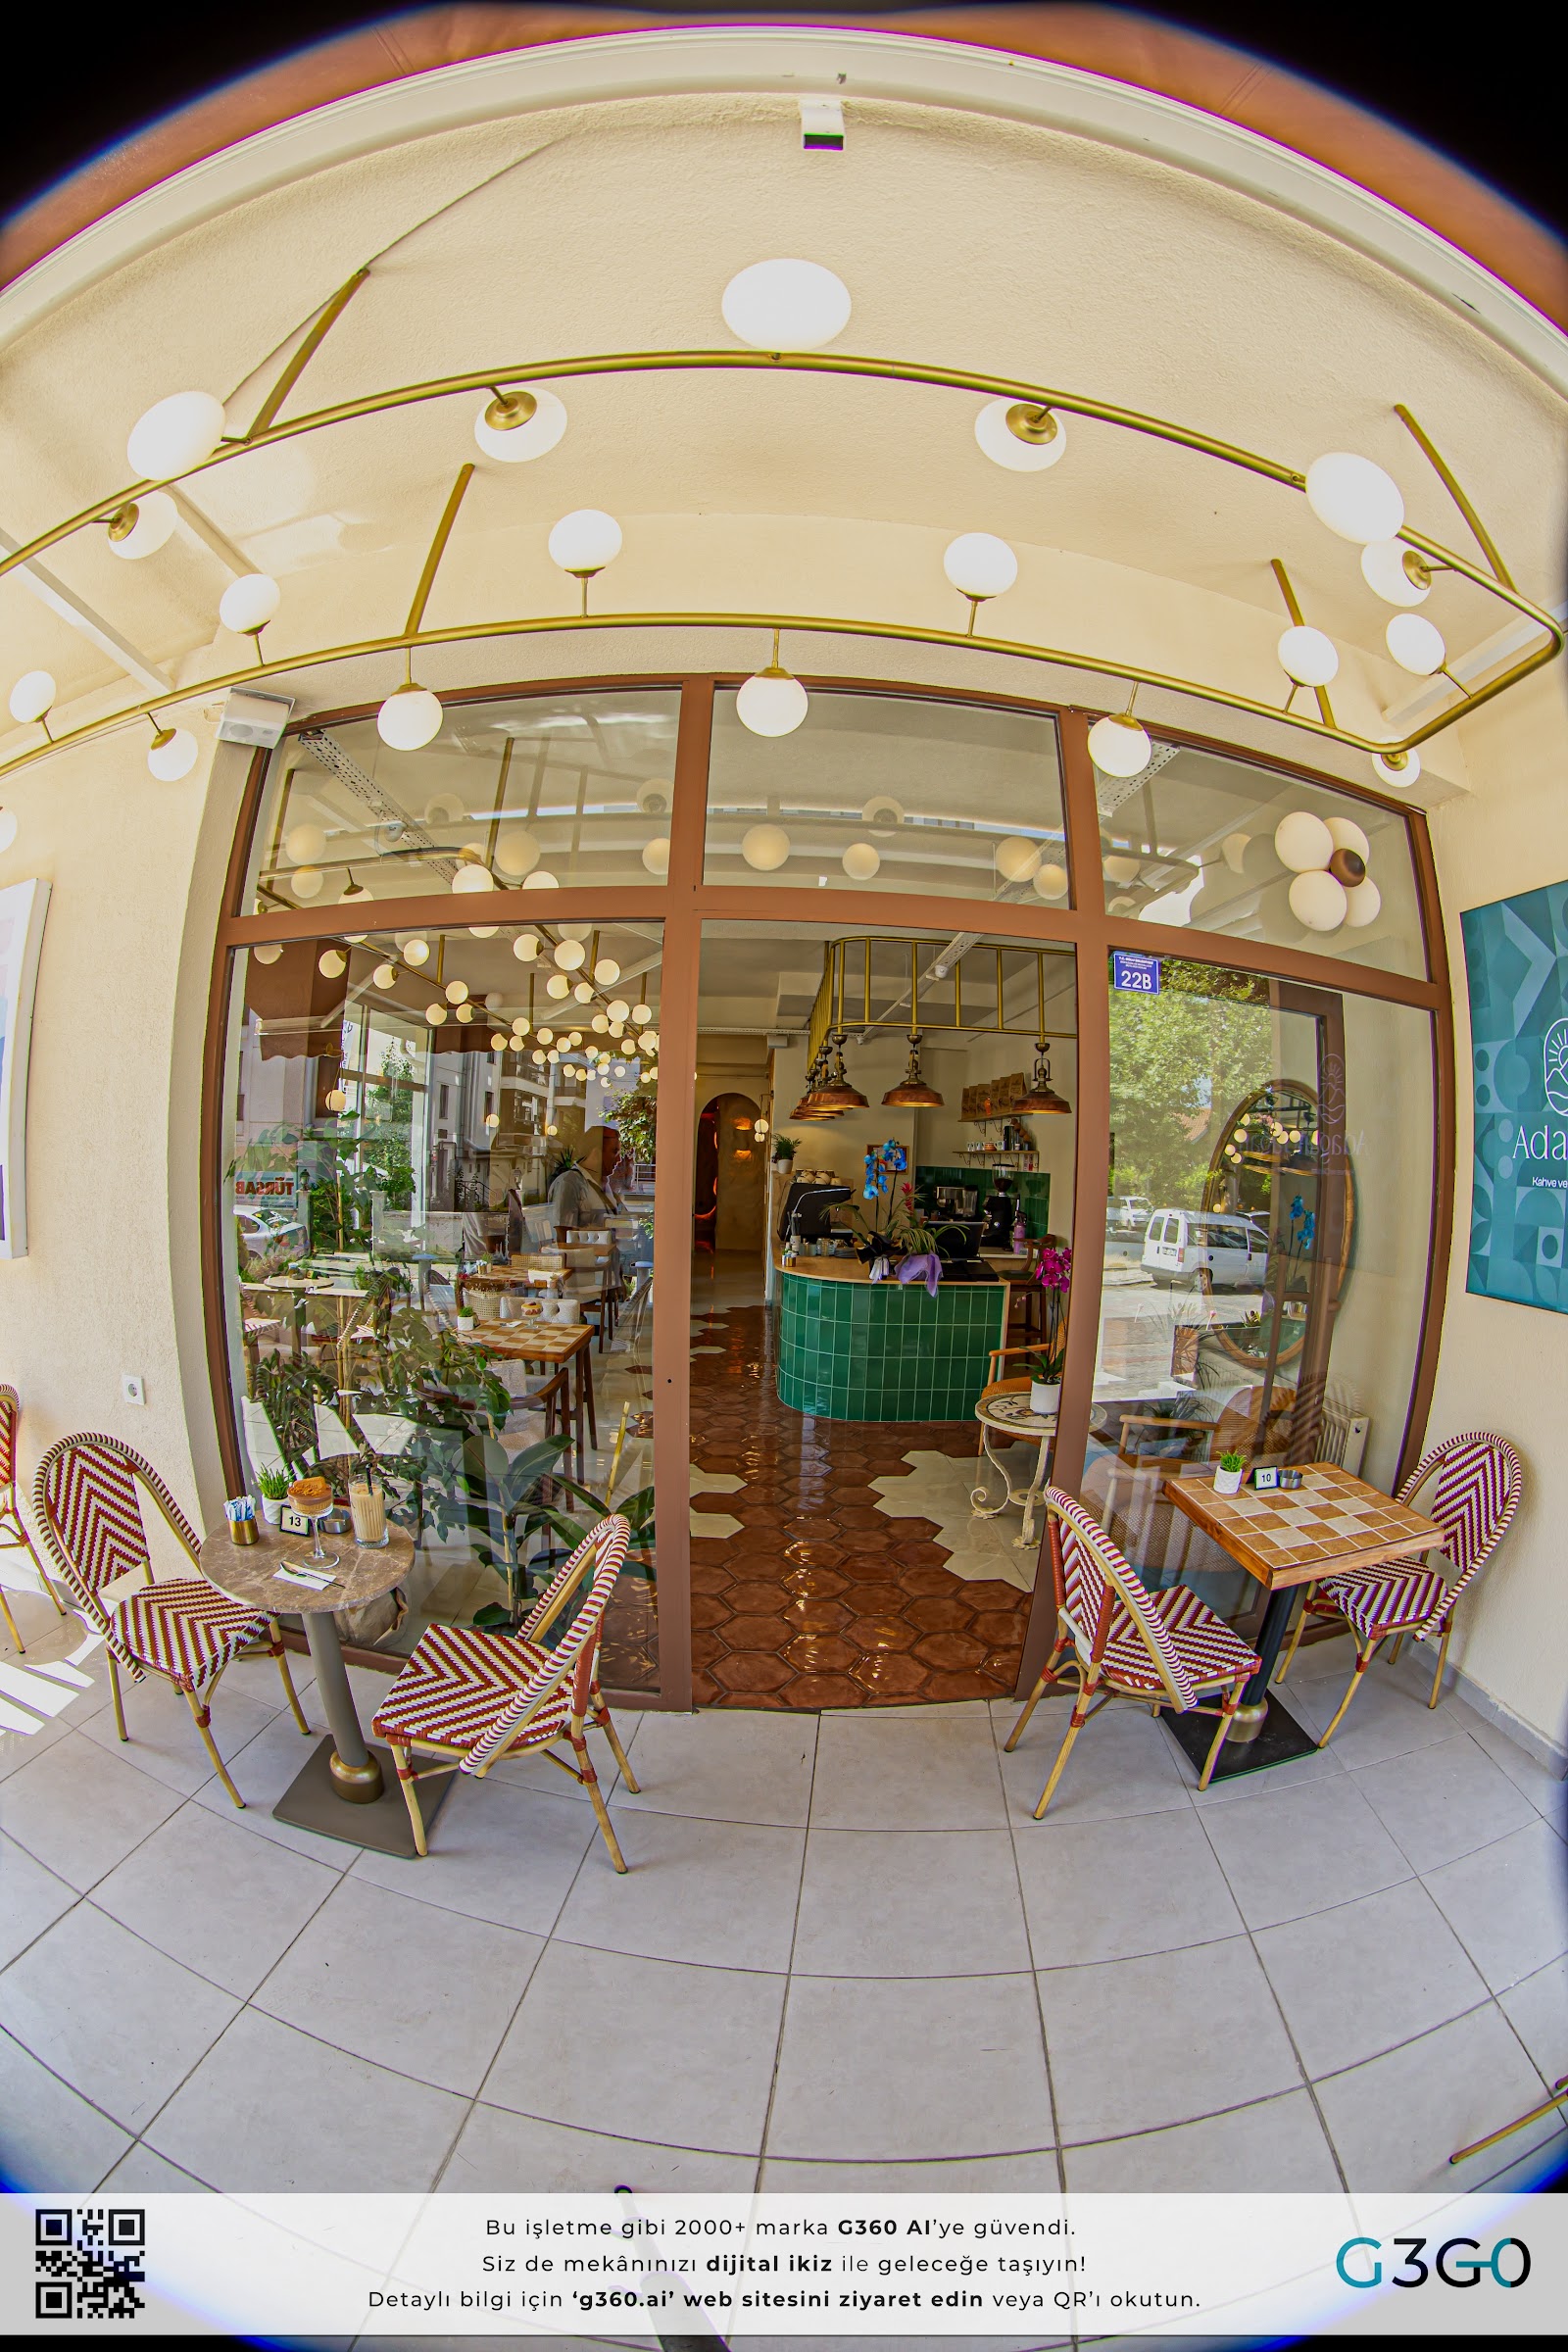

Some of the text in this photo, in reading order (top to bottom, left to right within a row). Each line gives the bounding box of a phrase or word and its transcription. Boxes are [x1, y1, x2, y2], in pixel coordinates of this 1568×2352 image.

[1121, 970, 1152, 990] 22B
[1512, 1124, 1568, 1160] Ada
[1532, 1176, 1557, 1188] Kahve
[1261, 1473, 1272, 1483] 10
[289, 1515, 302, 1527] 13
